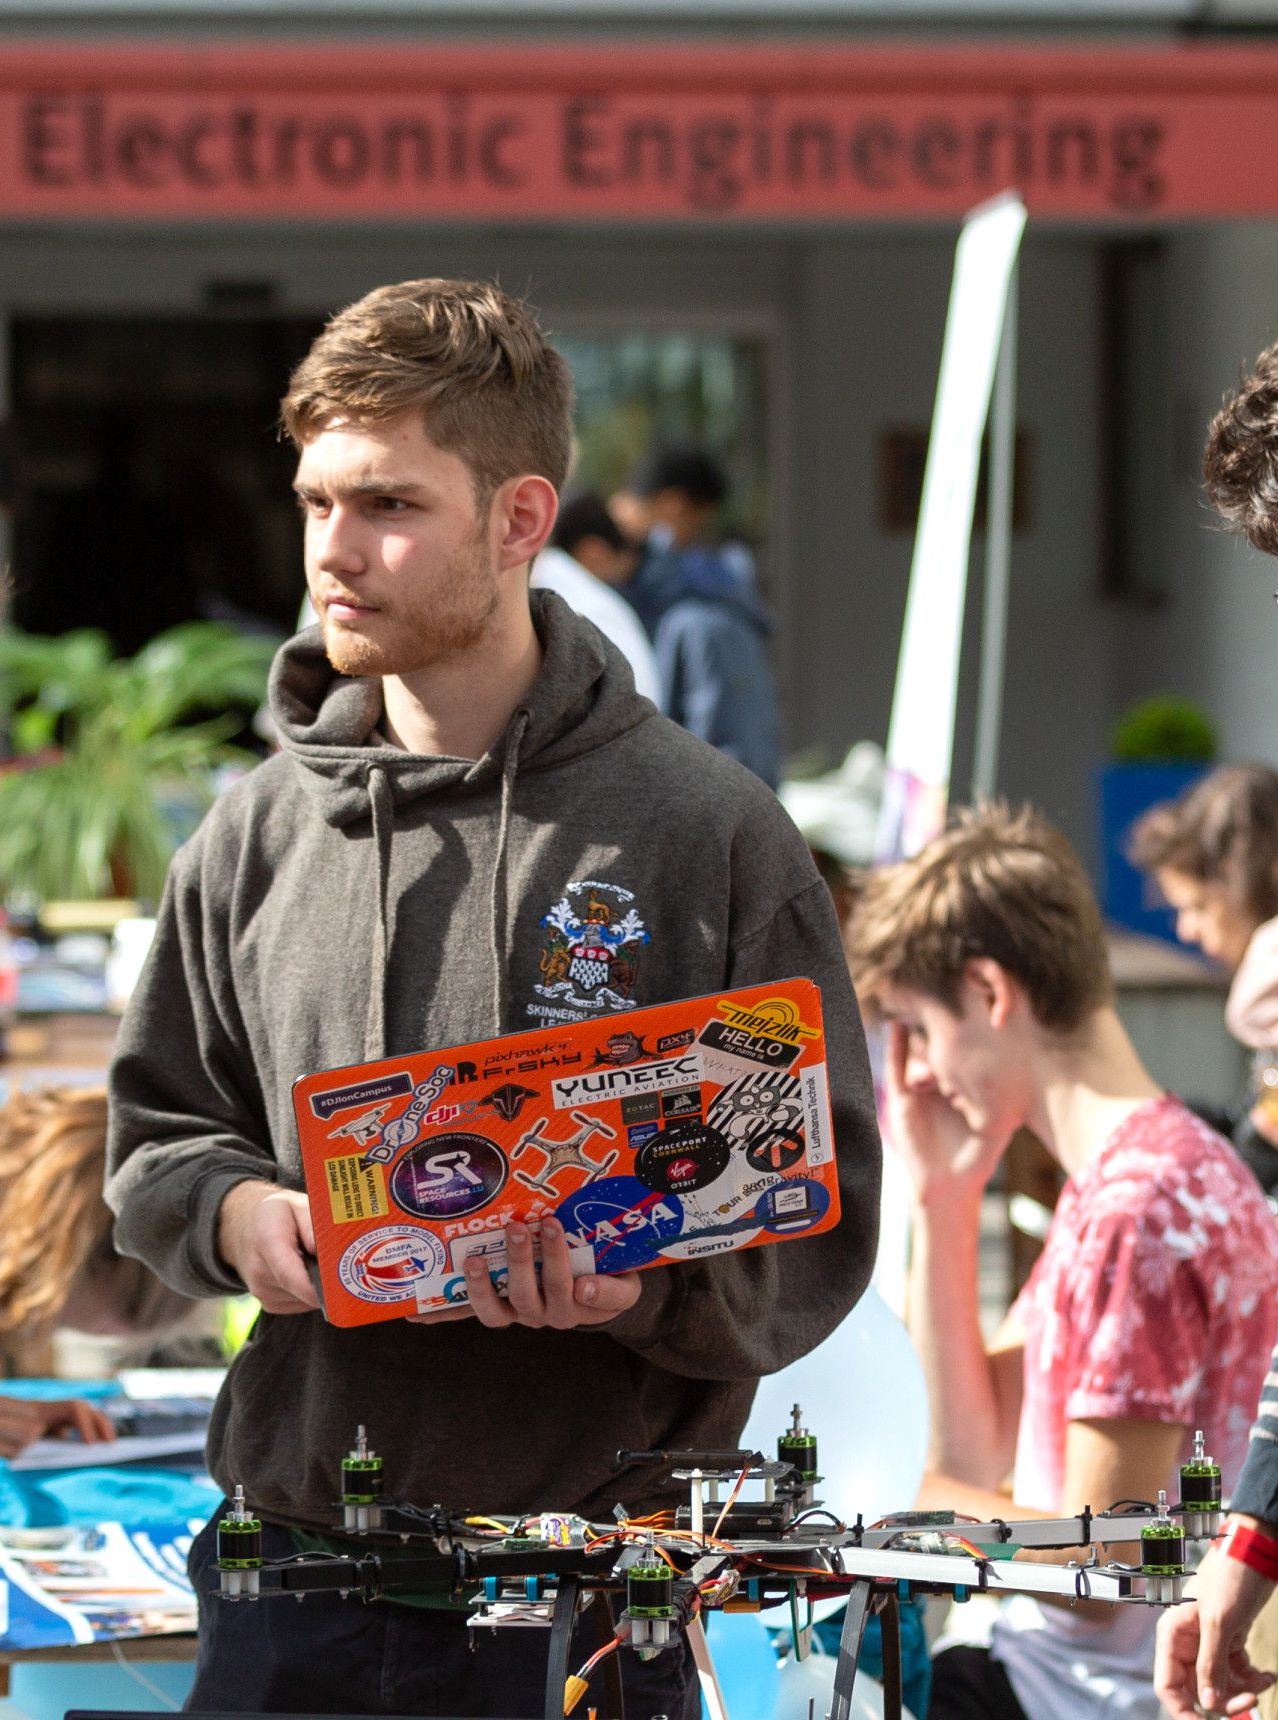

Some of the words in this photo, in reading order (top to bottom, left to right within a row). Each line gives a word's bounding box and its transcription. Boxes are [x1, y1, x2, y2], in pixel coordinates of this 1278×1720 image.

[18, 95, 523, 192] Electronic
[557, 97, 1168, 207] Engineering
[718, 1027, 784, 1057] HELLO
[723, 1043, 734, 1052] my
[736, 1046, 757, 1058] name
[555, 1055, 700, 1098] YUNEEC
[561, 1087, 627, 1107] ELECTRIC
[633, 1073, 700, 1093] AVIATION
[321, 1084, 393, 1108] #DJIonCampus
[805, 1076, 817, 1109] Technik
[435, 1134, 453, 1142] NEW
[810, 1107, 821, 1149] Lufthansa
[652, 1136, 708, 1153] SPACEPORT
[652, 1144, 701, 1159] CORNWALL
[365, 1169, 380, 1215] WARNING!
[418, 1187, 449, 1198] SPACE
[670, 1178, 698, 1190] ORBIT
[443, 1211, 514, 1239] FLOCK
[564, 1202, 679, 1250] NASA
[357, 1227, 395, 1245] SERVICE
[410, 1227, 436, 1245] MODEL
[433, 1242, 444, 1266] FLYING
[372, 1250, 410, 1263] MEMBER
[409, 1246, 428, 1257] 2017
[357, 1290, 388, 1303] UNITED
